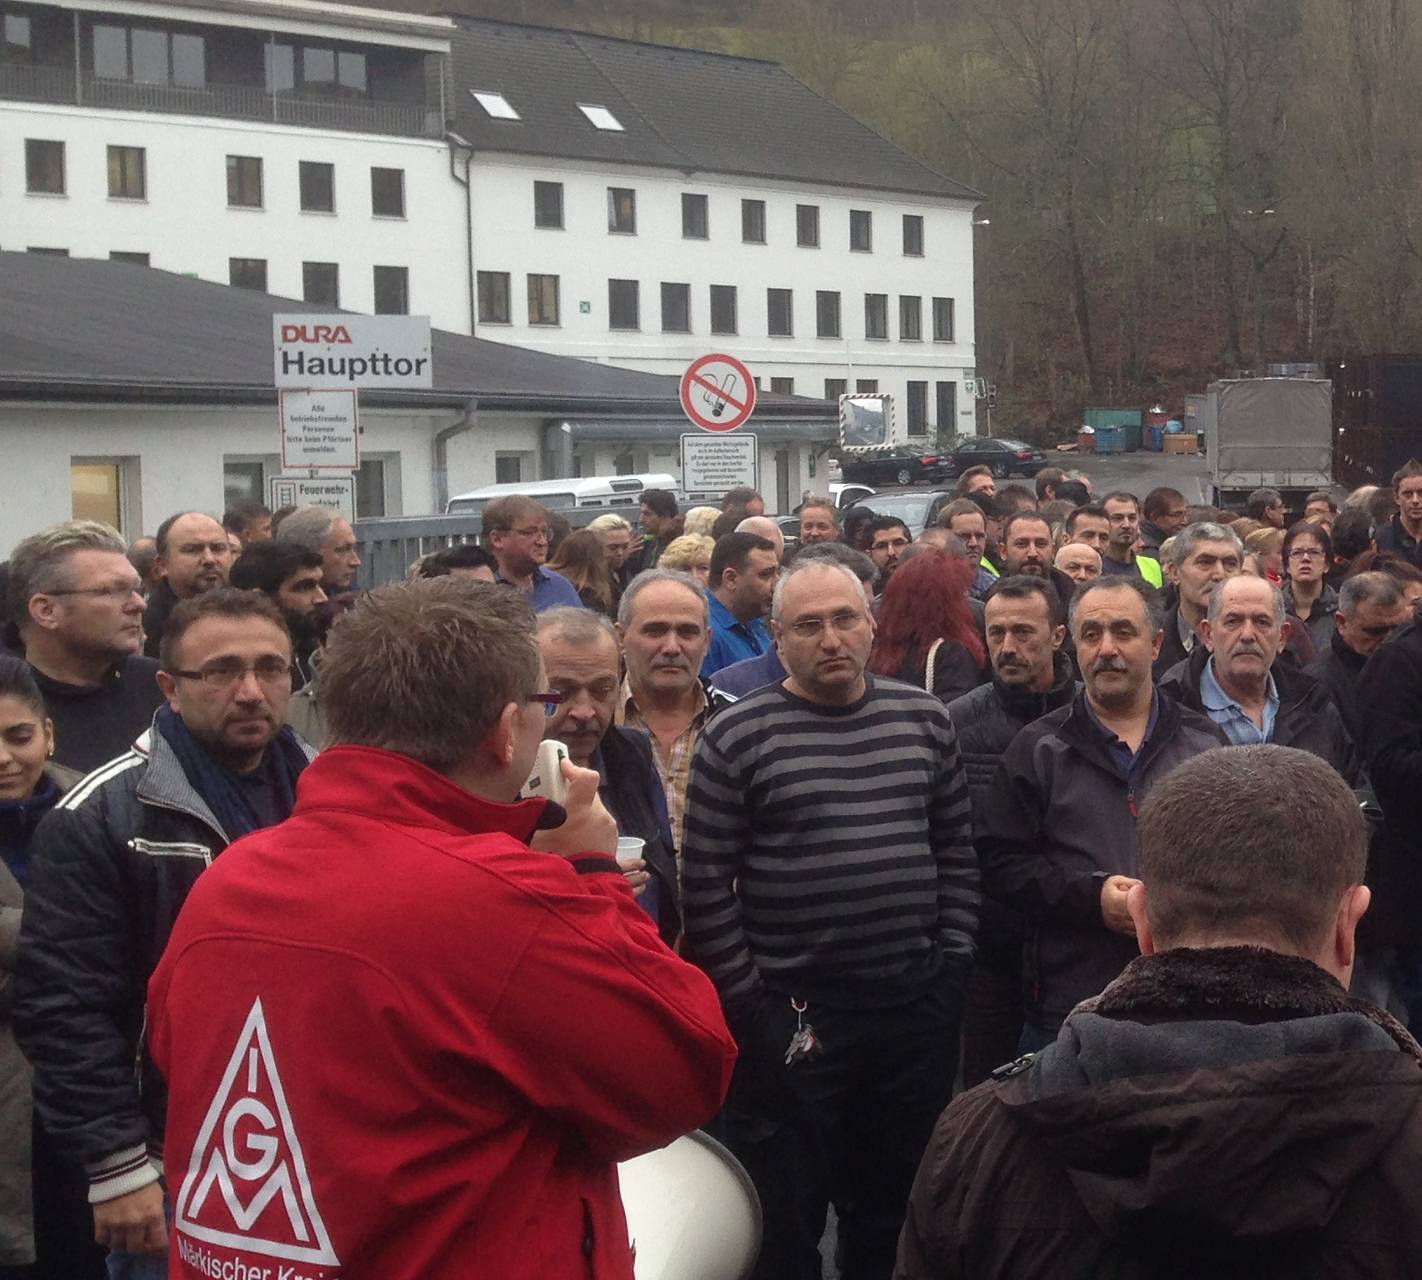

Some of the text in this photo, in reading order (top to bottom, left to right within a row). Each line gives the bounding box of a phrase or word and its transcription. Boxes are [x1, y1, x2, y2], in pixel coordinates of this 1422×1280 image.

[281, 325, 352, 344] DURA
[282, 351, 428, 381] Haupttor
[300, 484, 348, 495] Feuerwehr-
[177, 1235, 272, 1280] Märkischer
